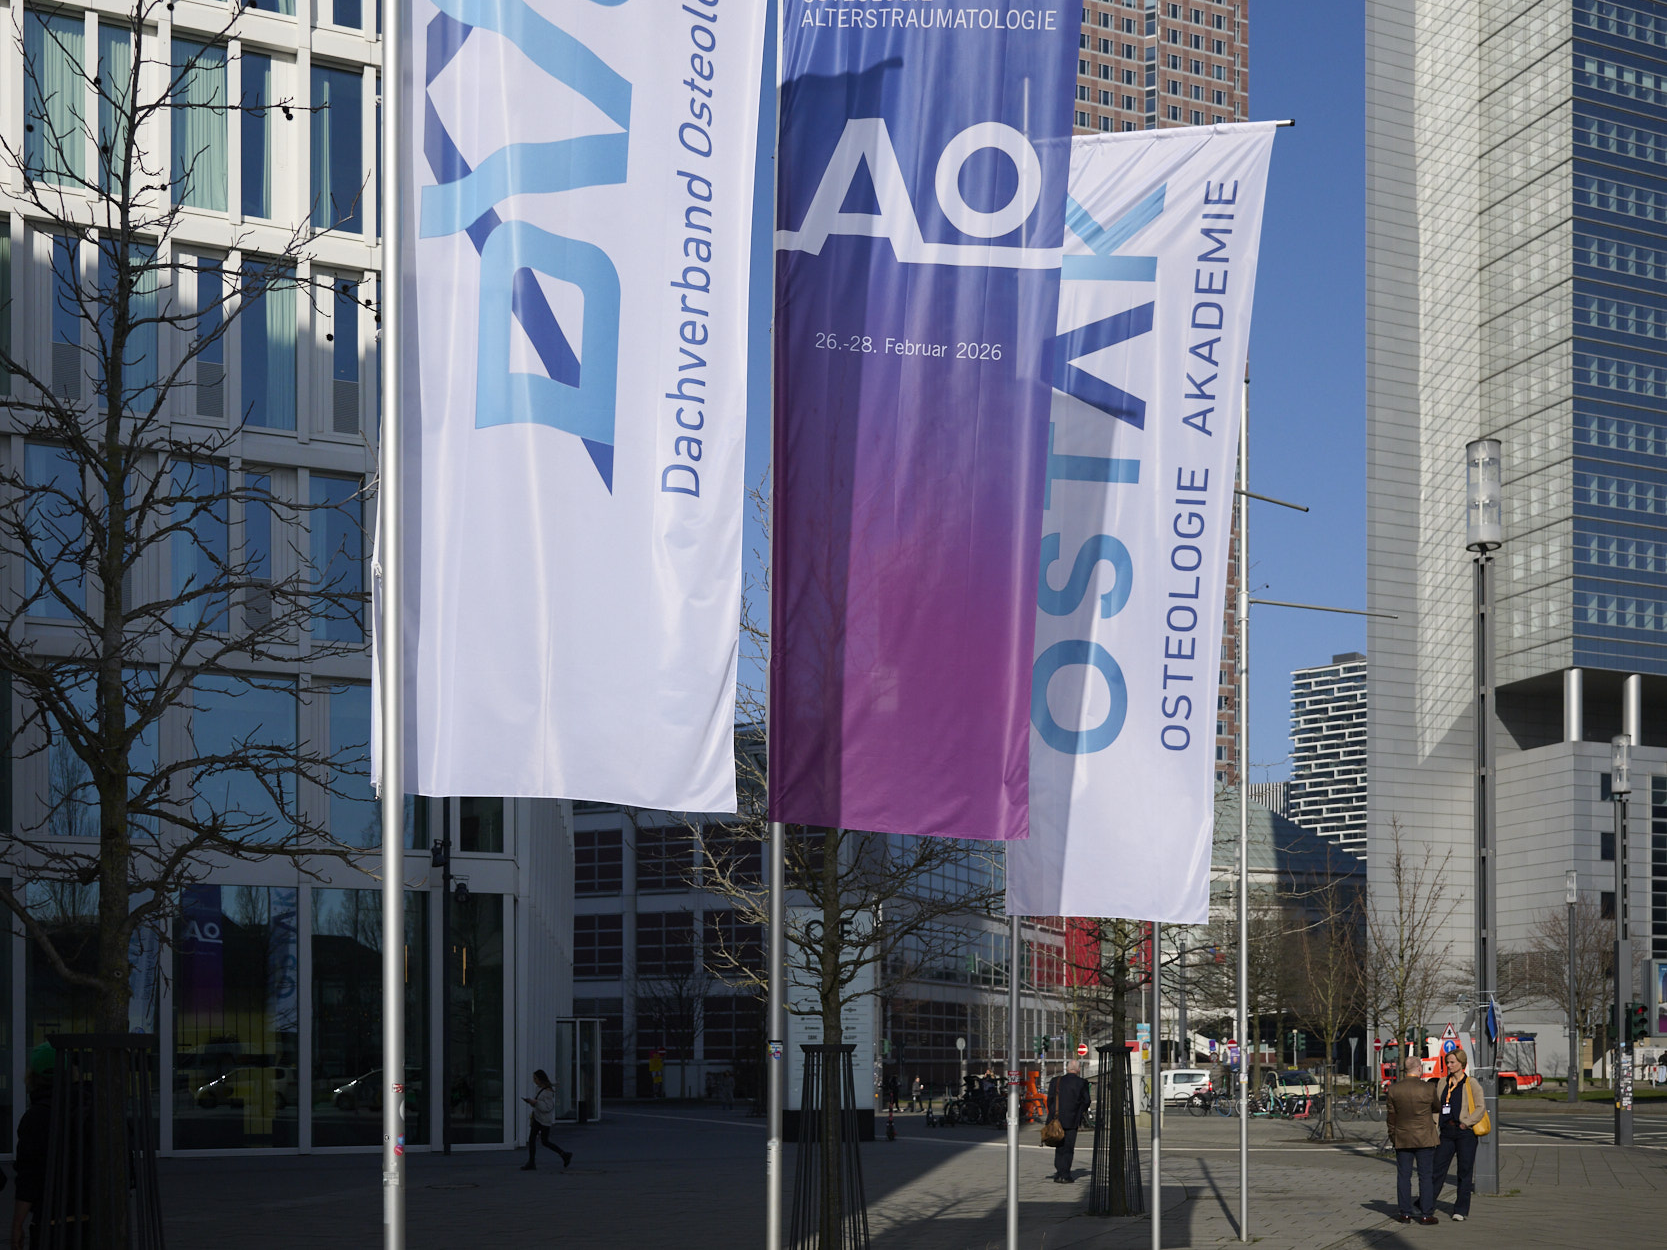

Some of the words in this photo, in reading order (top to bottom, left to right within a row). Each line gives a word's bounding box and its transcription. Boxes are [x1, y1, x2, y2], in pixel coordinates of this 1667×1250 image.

[801, 8, 1057, 30] ALTERSTRAUMATOLOGIE
[776, 117, 1063, 269] AO
[661, 170, 713, 498] Dachverband
[815, 332, 877, 354] 26.-28.
[885, 337, 948, 358] Februar
[956, 342, 1003, 361] 2026
[1181, 179, 1239, 438] AKADEMIE
[1030, 181, 1168, 755] OSTAK
[1160, 466, 1209, 751] OSTEOLOGIE
[805, 919, 853, 944] OE
